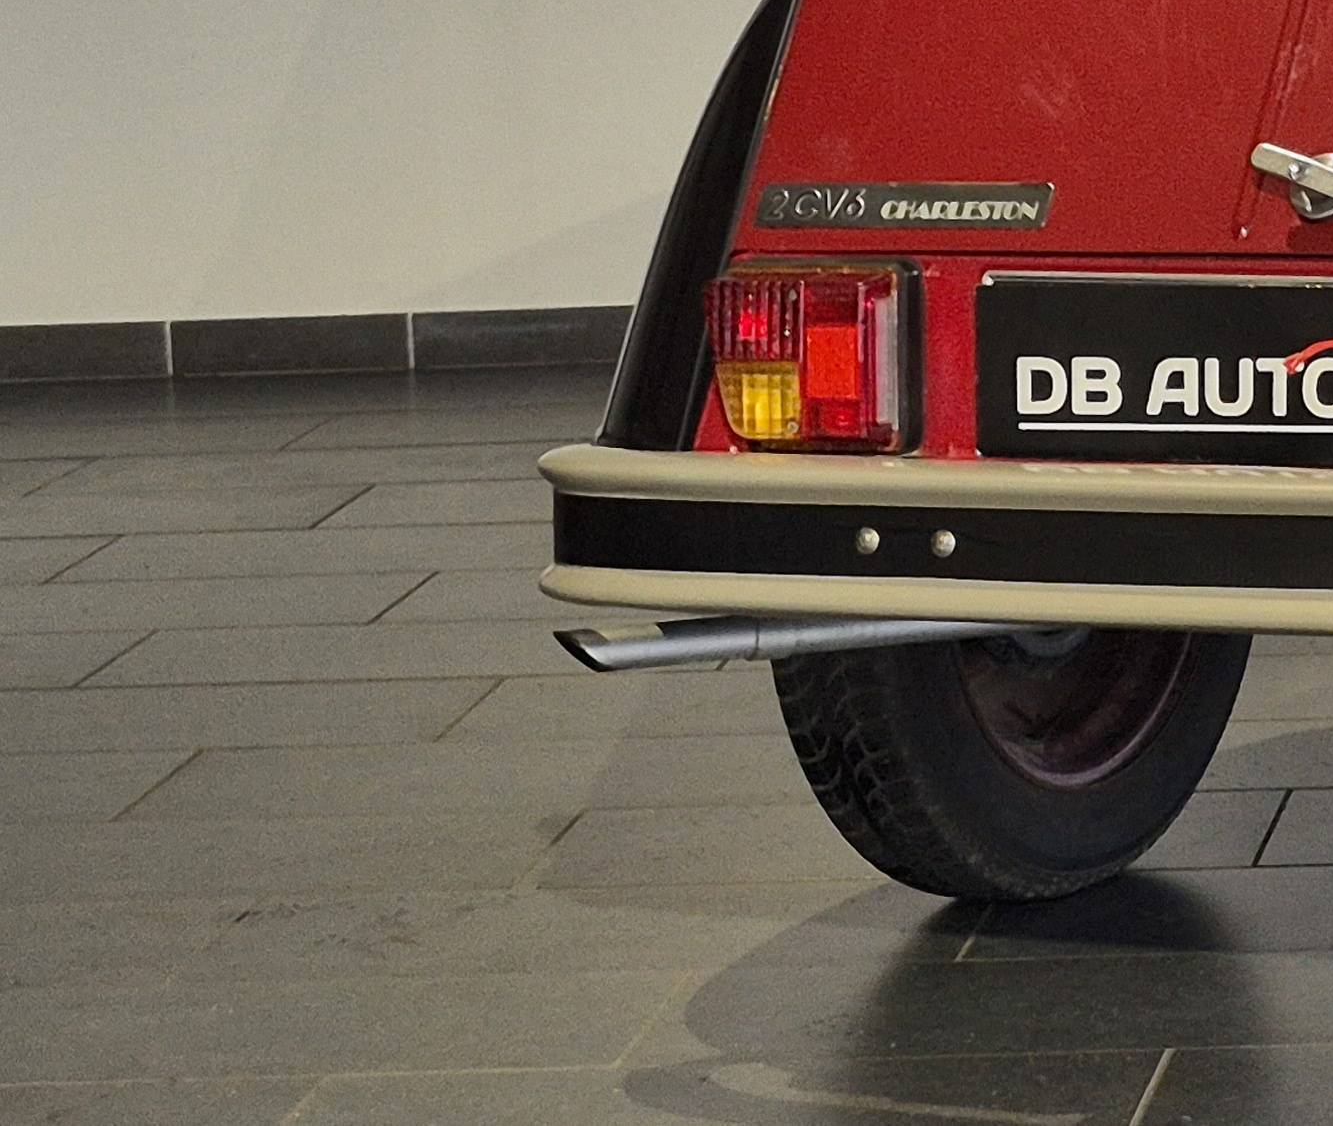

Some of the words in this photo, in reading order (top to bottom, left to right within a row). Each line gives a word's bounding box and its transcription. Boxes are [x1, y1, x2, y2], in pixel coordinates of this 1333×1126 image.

[765, 188, 867, 222] 2CV6
[879, 199, 1041, 222] CHARLESTON
[1016, 356, 1123, 416] DB
